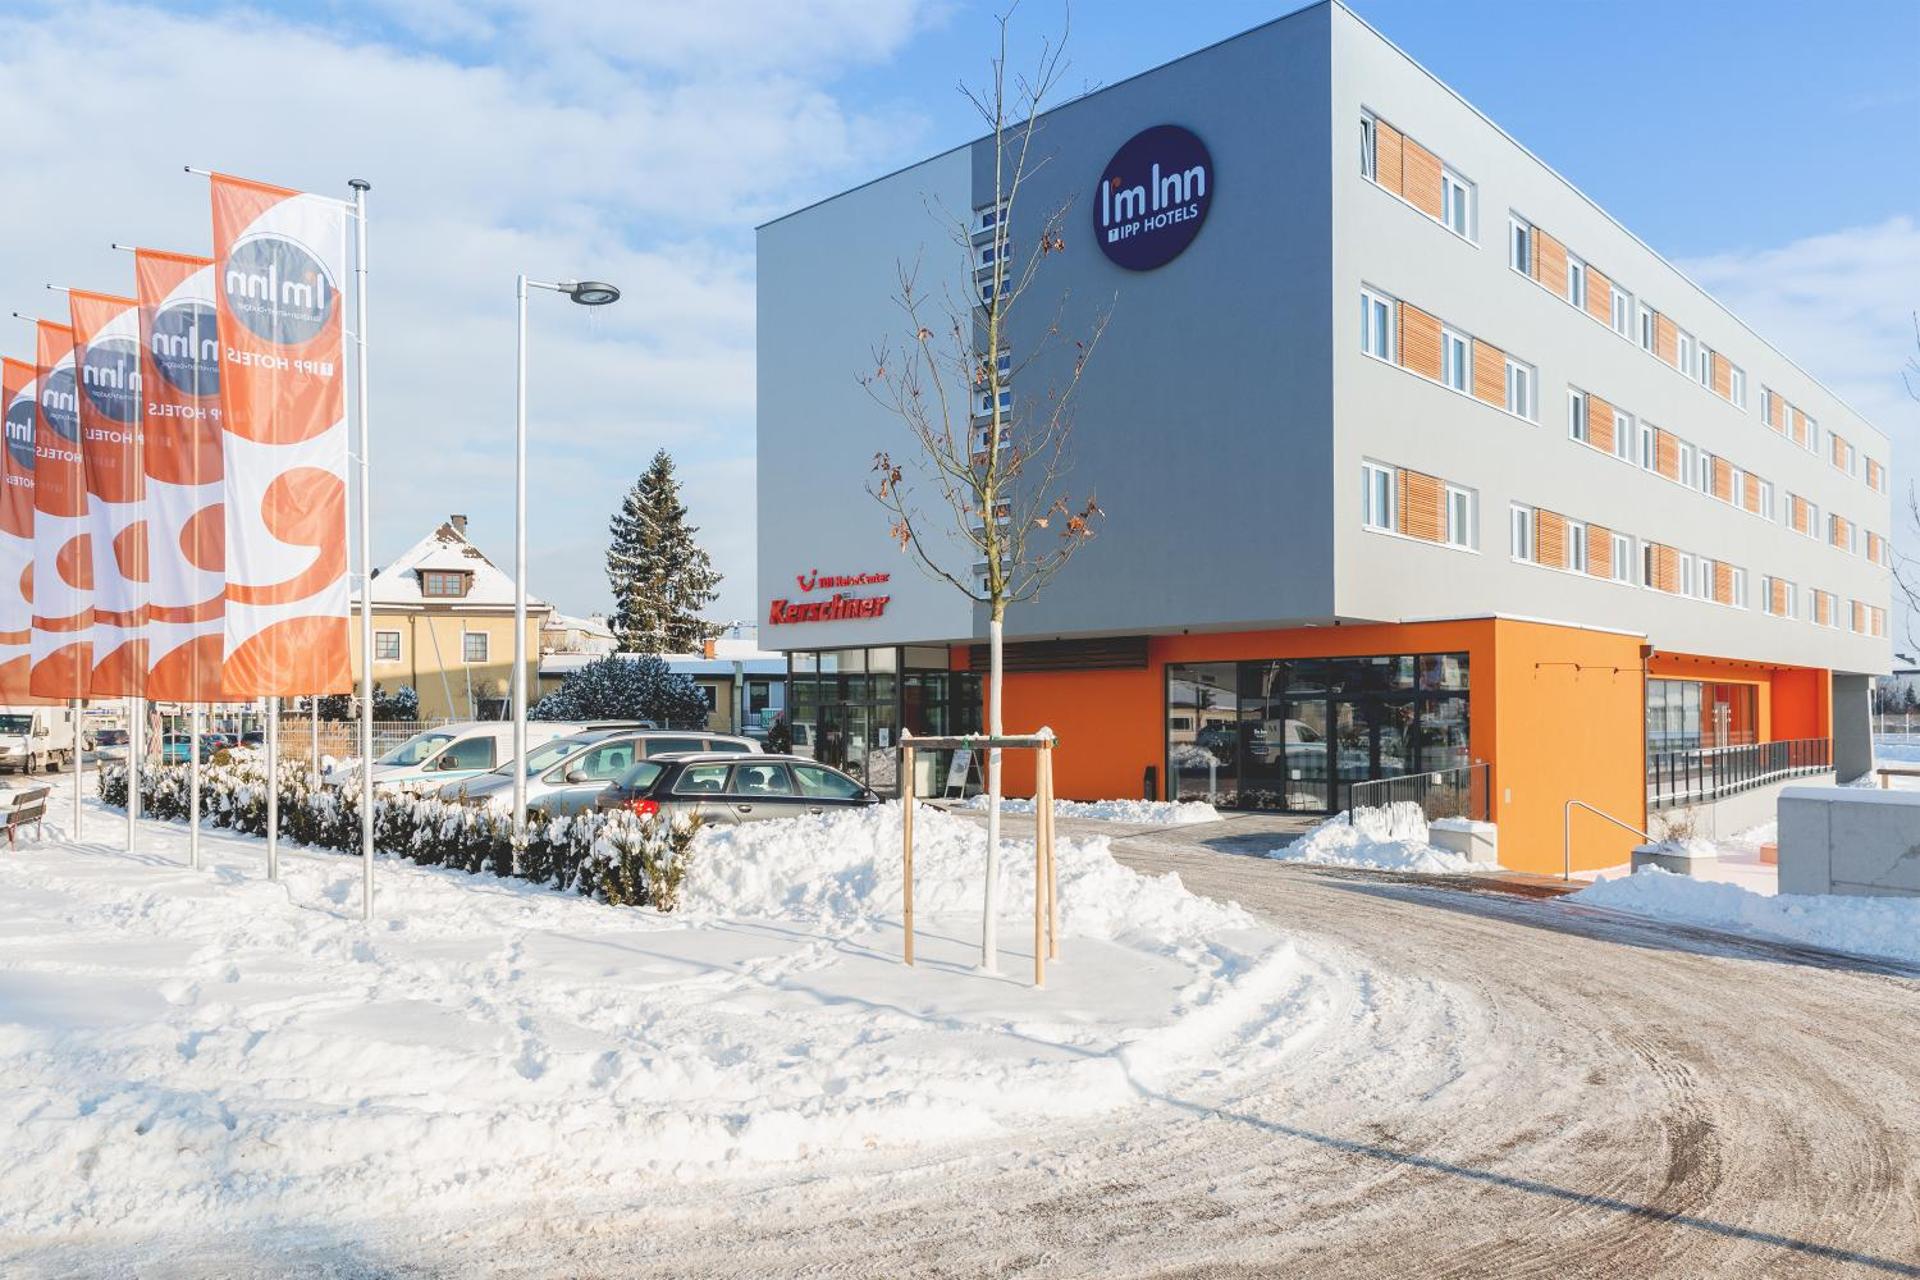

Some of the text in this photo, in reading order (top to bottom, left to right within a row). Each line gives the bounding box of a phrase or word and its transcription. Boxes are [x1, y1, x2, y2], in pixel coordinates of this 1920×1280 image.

[1103, 163, 1205, 227] I'm Inn
[1120, 203, 1198, 239] IPP HOTELS
[769, 593, 890, 624] Kerschner
